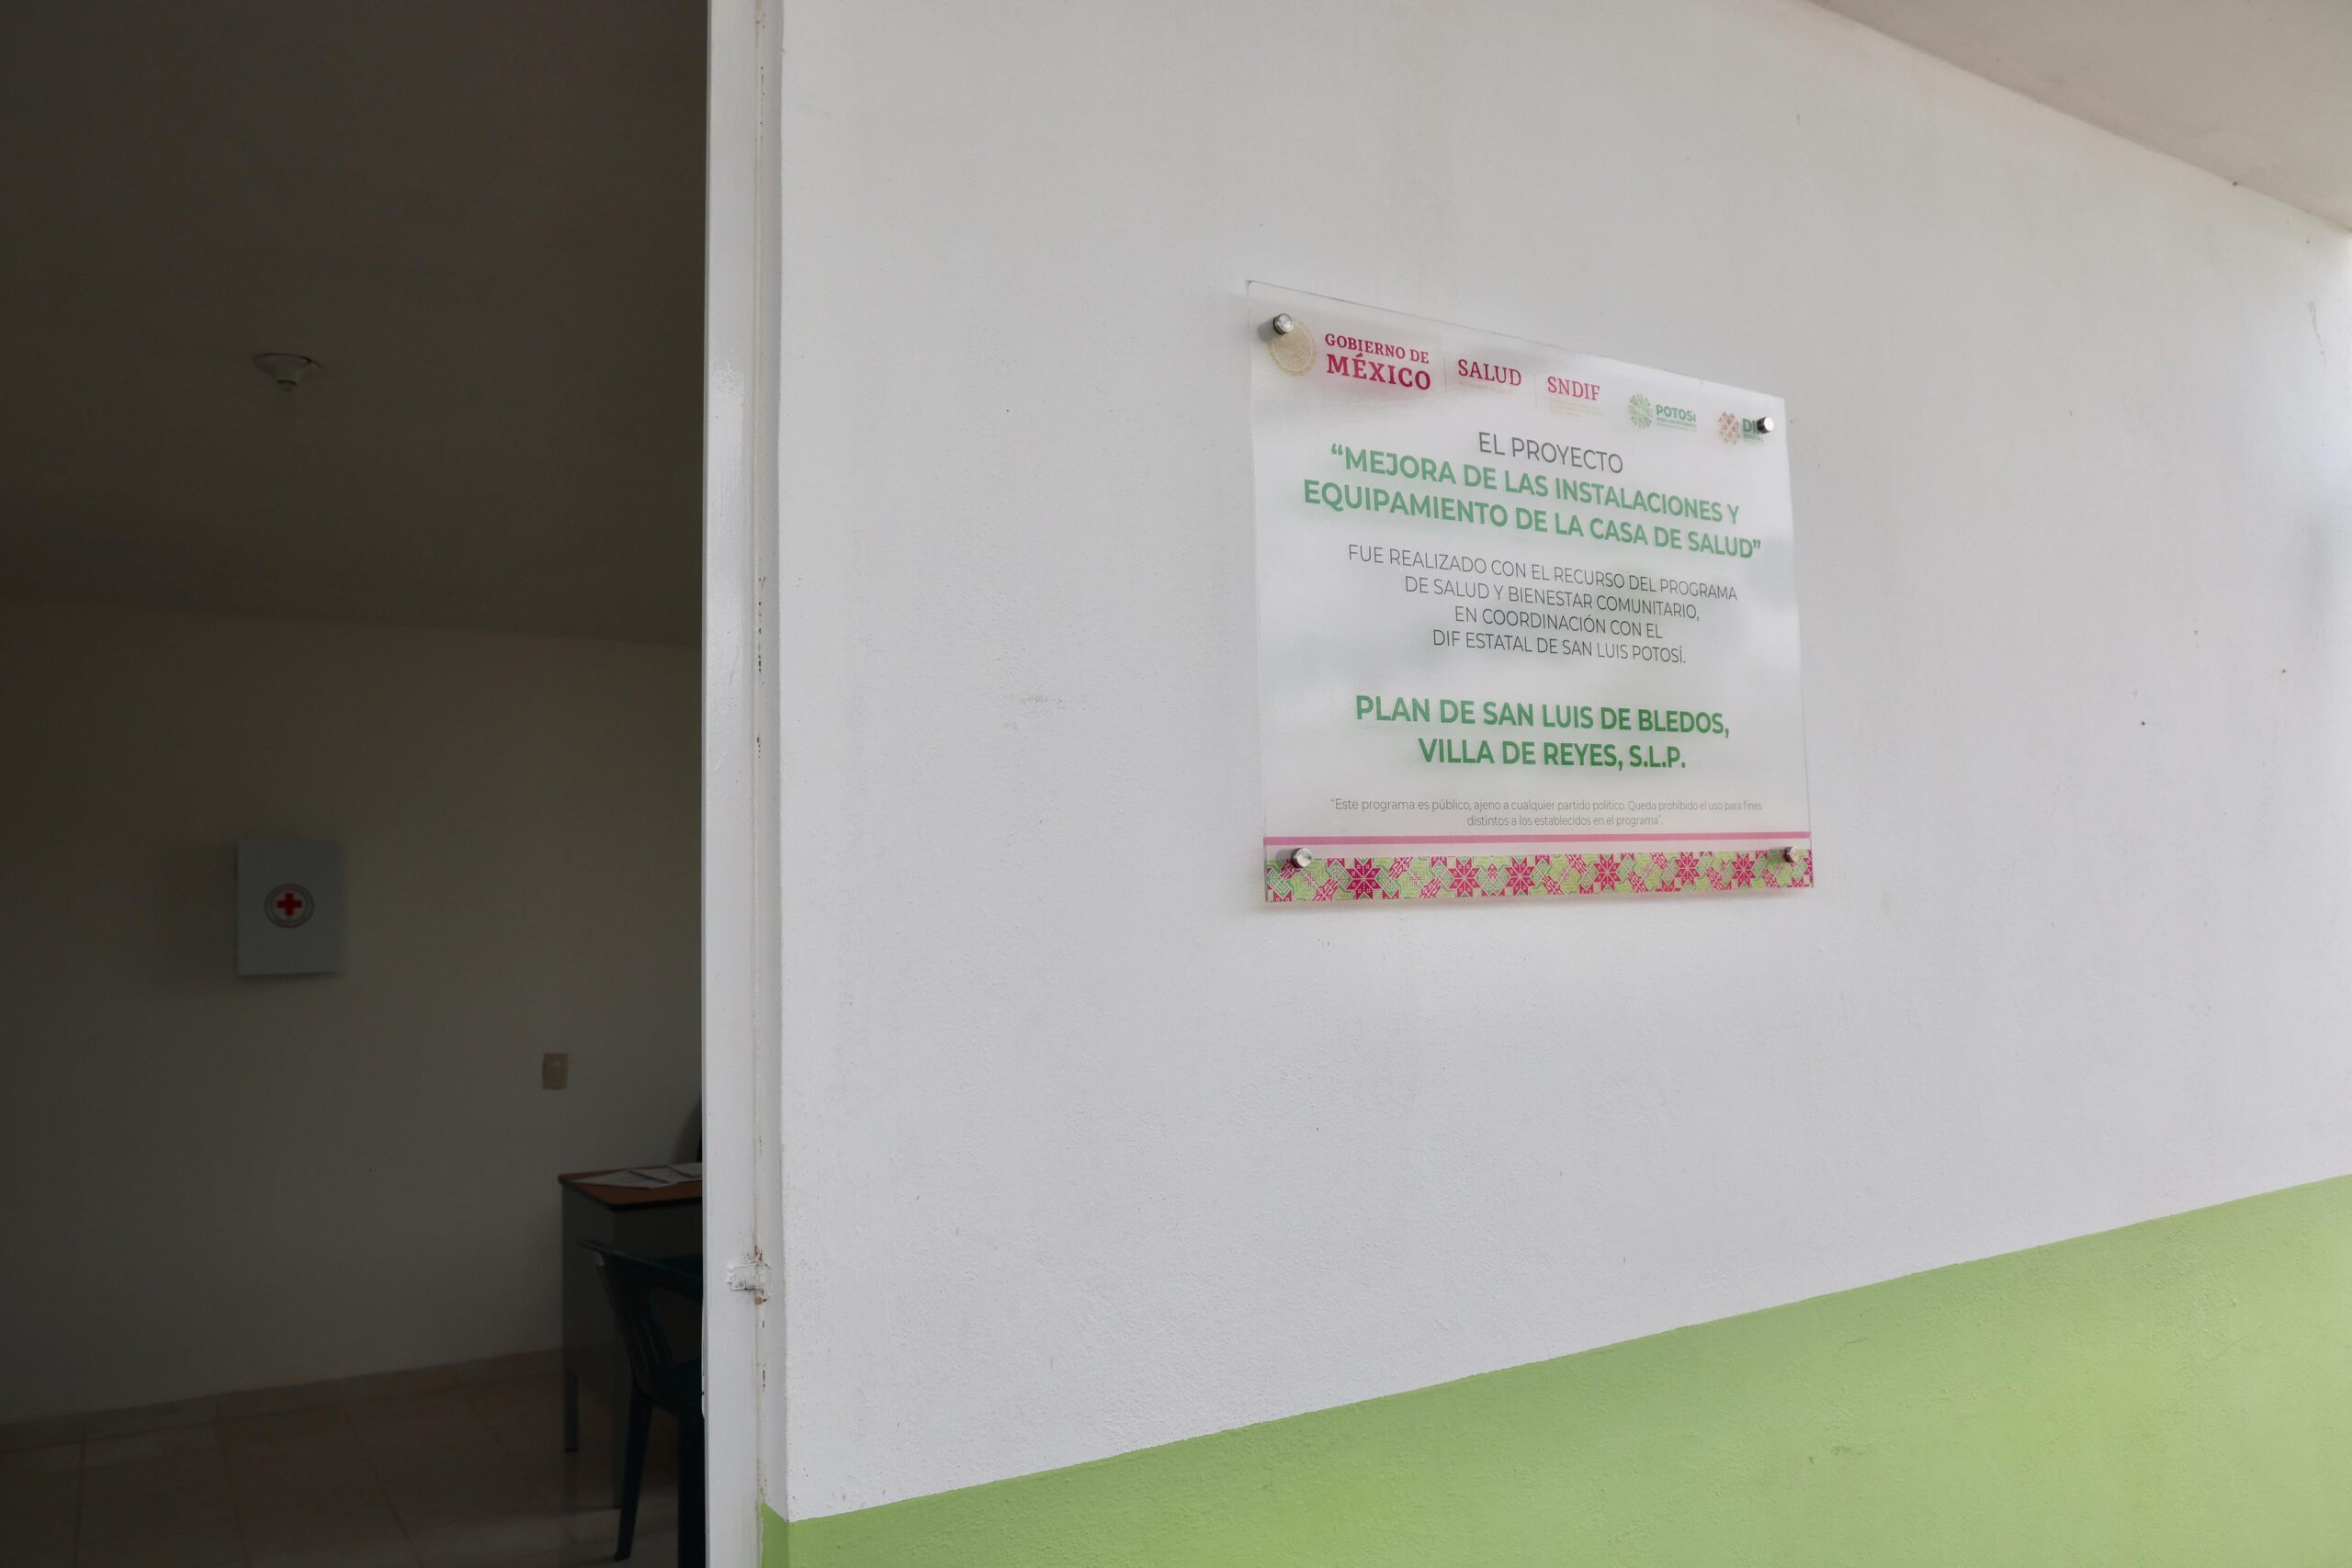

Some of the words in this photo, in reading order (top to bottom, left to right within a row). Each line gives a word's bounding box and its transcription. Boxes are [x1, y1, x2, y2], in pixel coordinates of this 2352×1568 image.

[1325, 333, 1405, 359] GOBIERNO
[1410, 349, 1429, 364] DE
[1327, 353, 1431, 390] MÉXICO
[1458, 358, 1521, 386] SALUD
[1547, 376, 1600, 401] SNDIF
[1743, 419, 1762, 434] DI
[1479, 432, 1505, 457] EL
[1512, 437, 1623, 474] PROYECTO
[1465, 465, 1497, 490] DE
[1506, 470, 1547, 497] LAS
[1555, 478, 1723, 522] INSTALACIONES
[1727, 504, 1739, 524] Y
[1304, 480, 1508, 527] EQUIPAMIENTO
[1517, 509, 1547, 532] DE
[1555, 513, 1583, 537] LA
[1589, 518, 1647, 546] CASA
[1656, 526, 1682, 550] DE
[1349, 545, 1384, 564] FUE
[1390, 548, 1486, 574] REALIZADO
[1491, 559, 1525, 578] CON
[1532, 564, 1550, 581] EL
[1555, 568, 1624, 589] RECURSO
[1629, 574, 1657, 592] DEL
[1660, 579, 1737, 601] PROGRAMA
[1406, 576, 1428, 593] DE
[1433, 580, 1489, 599] SALUD
[1494, 584, 1504, 600] Y
[1509, 586, 1592, 609] BIENESTAR
[1597, 595, 1700, 622] COMUNITARIO,
[1455, 606, 1476, 623] EN
[1483, 609, 1605, 637] COORDINACIÓN
[1610, 621, 1642, 637] CON
[1647, 624, 1663, 638] EL
[1433, 630, 1459, 648] DIF
[1466, 633, 1532, 653] ESTATAL
[1537, 638, 1558, 655] DE
[1563, 640, 1592, 657] SAN
[1598, 643, 1628, 660] LUIS
[1633, 645, 1686, 664] POTOSÍ.
[1356, 695, 1430, 722] PLAN
[1441, 699, 1474, 724] DE
[1483, 702, 1533, 727] SAN
[1543, 705, 1593, 728] LUIS
[1601, 706, 1632, 730] DE
[1639, 709, 1729, 738] BLEDOS,
[1419, 738, 1493, 763] VILLA
[1503, 741, 1535, 764] DE
[1544, 743, 1623, 772] REYES,
[1629, 746, 1686, 769] S.L.P.
[1362, 801, 1415, 812] programa
[1418, 801, 1430, 810] es
[1474, 800, 1500, 812] ajeno
[1503, 802, 1509, 810] a
[1511, 799, 1555, 812] cualquier
[1557, 800, 1590, 812] partido
[1628, 801, 1657, 811] Queda
[1658, 801, 1698, 812] prohibido
[1699, 801, 1707, 810] el
[1709, 802, 1723, 810] uso
[1724, 802, 1742, 812] para
[1467, 816, 1509, 826] distintos
[1511, 818, 1517, 826] a
[1519, 816, 1532, 826] los
[1534, 816, 1591, 826] establecidos
[1593, 817, 1604, 826] en
[1607, 816, 1613, 826] el
